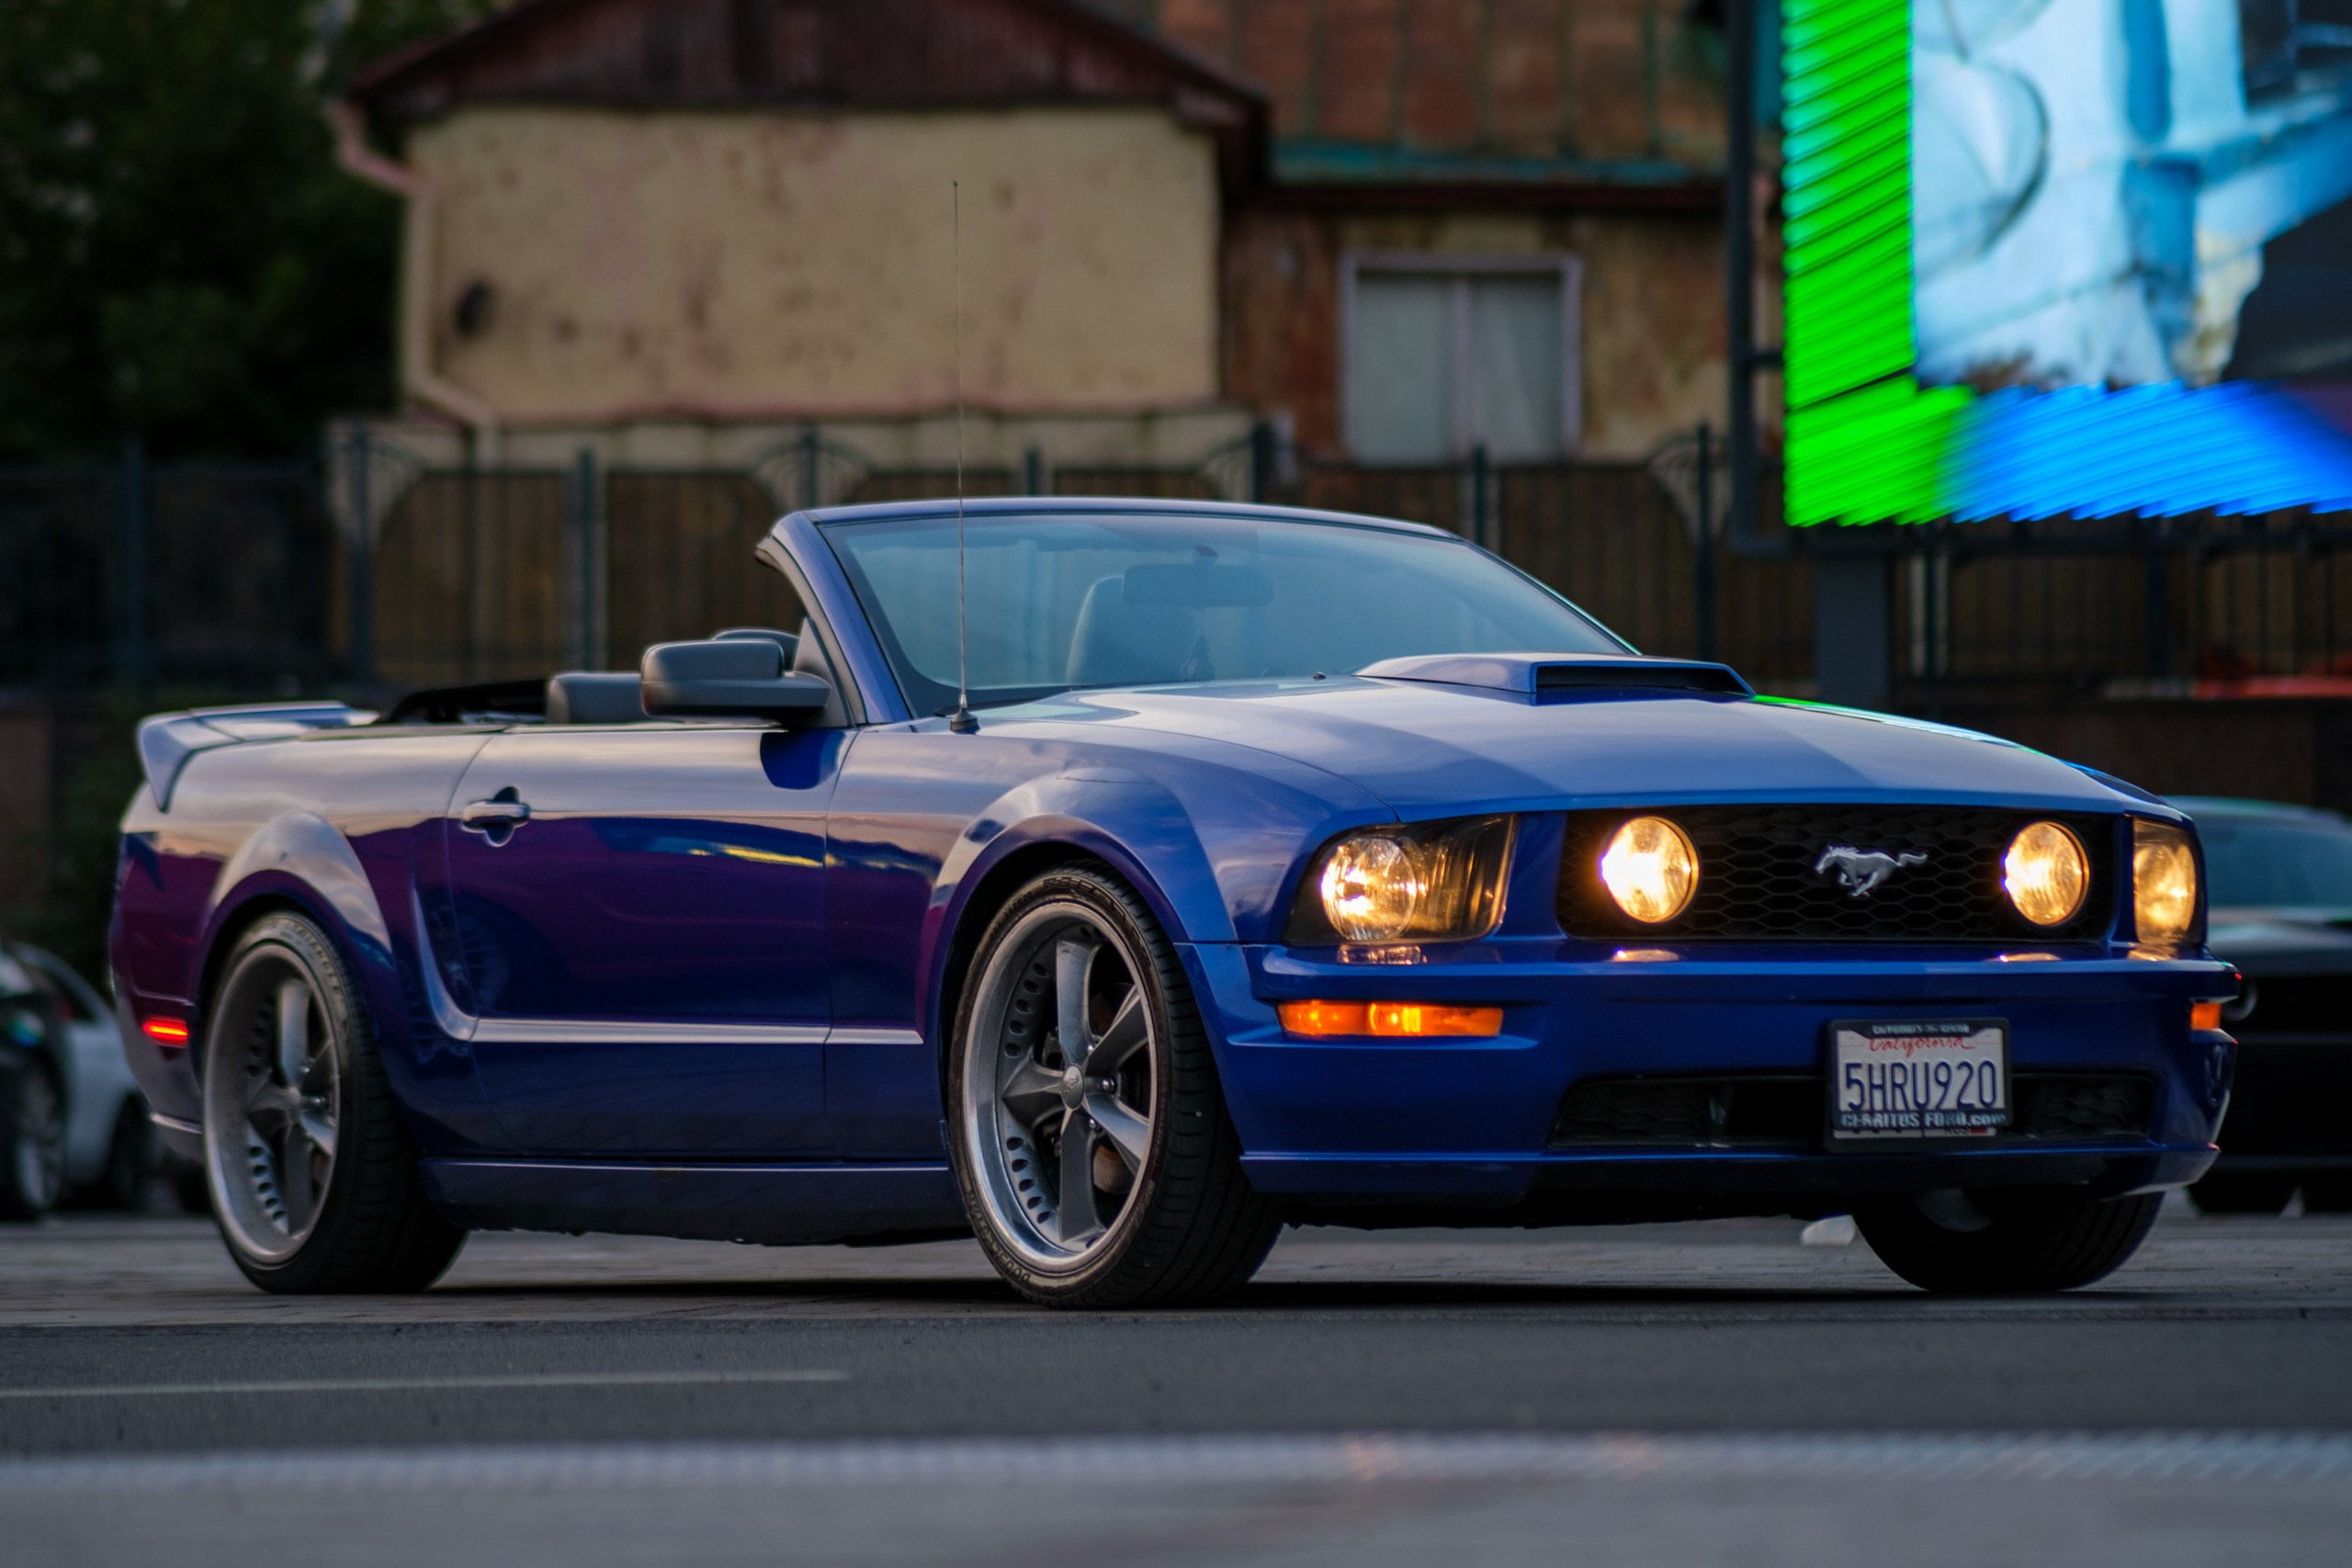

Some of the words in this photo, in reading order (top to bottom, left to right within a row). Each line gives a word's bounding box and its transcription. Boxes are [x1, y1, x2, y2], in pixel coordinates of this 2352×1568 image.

[1869, 1036, 1974, 1058] California
[1845, 1059, 1997, 1111] 5HRU920
[1840, 1111, 1920, 1128] CERRITOS
